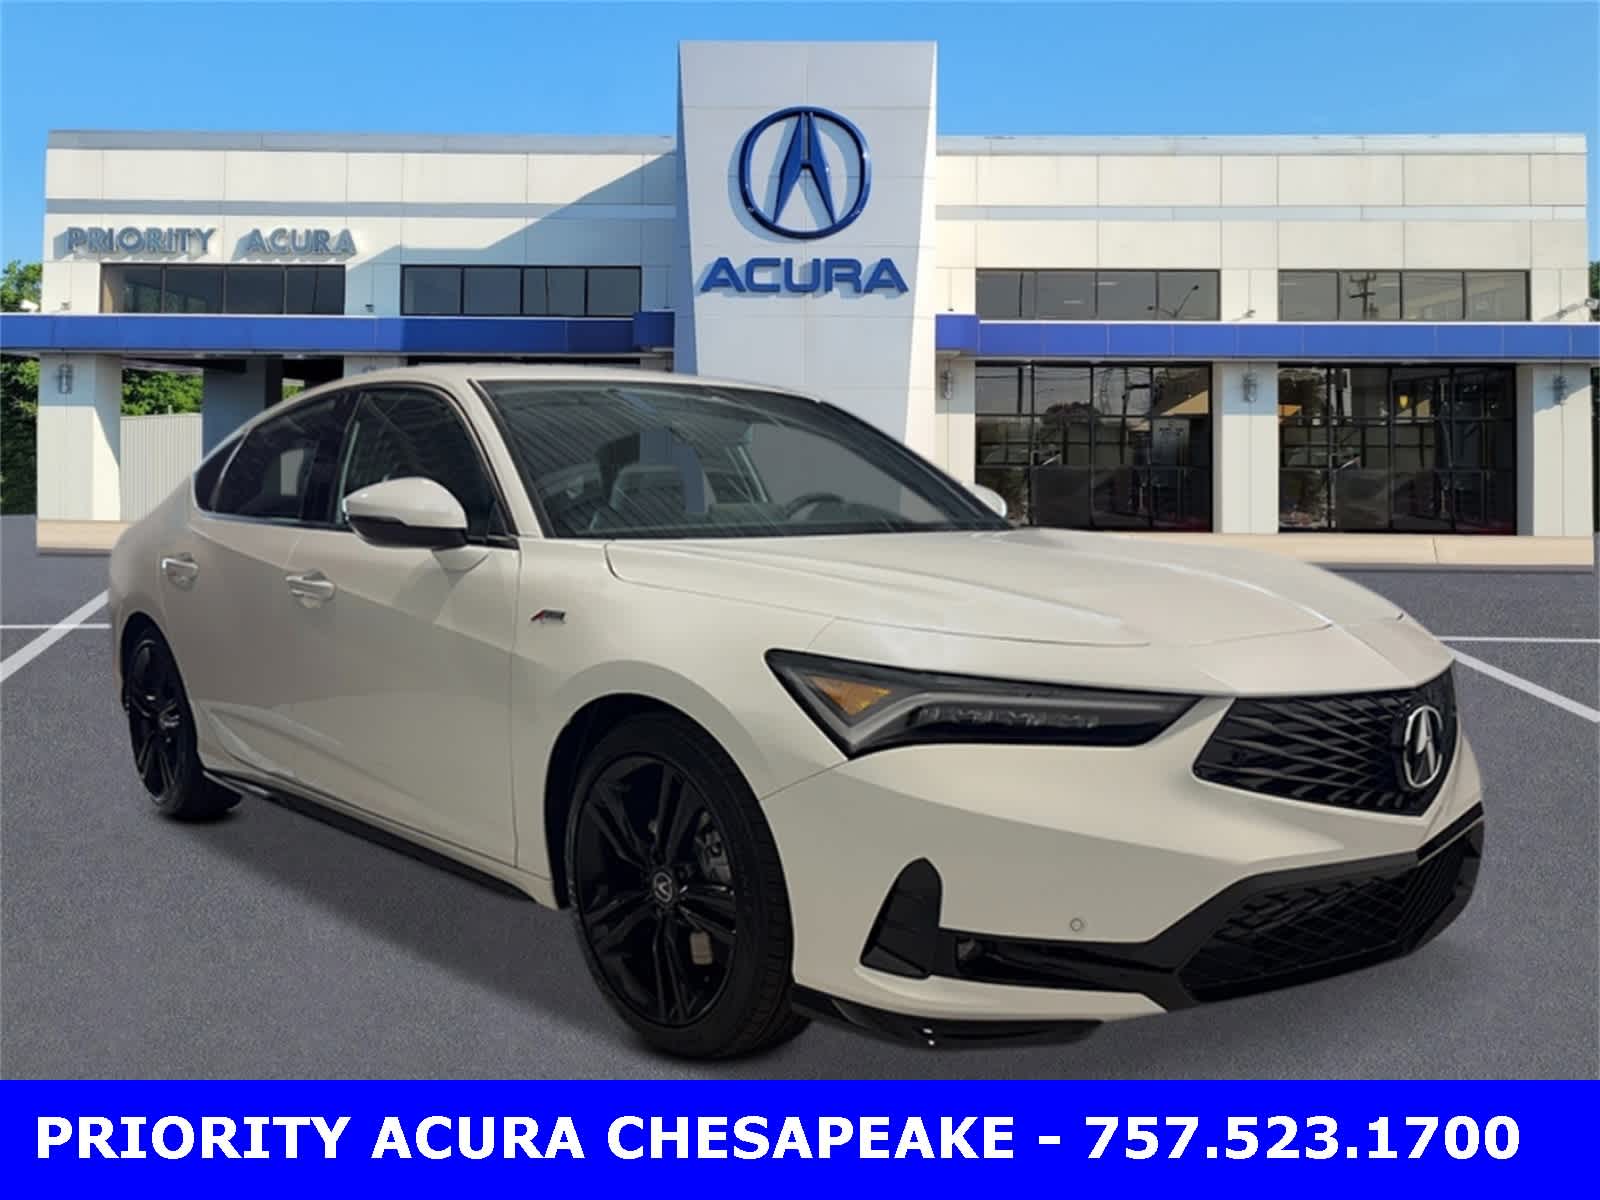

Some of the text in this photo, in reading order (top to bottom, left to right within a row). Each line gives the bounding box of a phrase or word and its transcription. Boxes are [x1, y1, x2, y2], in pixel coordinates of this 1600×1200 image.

[66, 227, 357, 255] PRIORITY ACURA
[700, 257, 909, 294] ACURA
